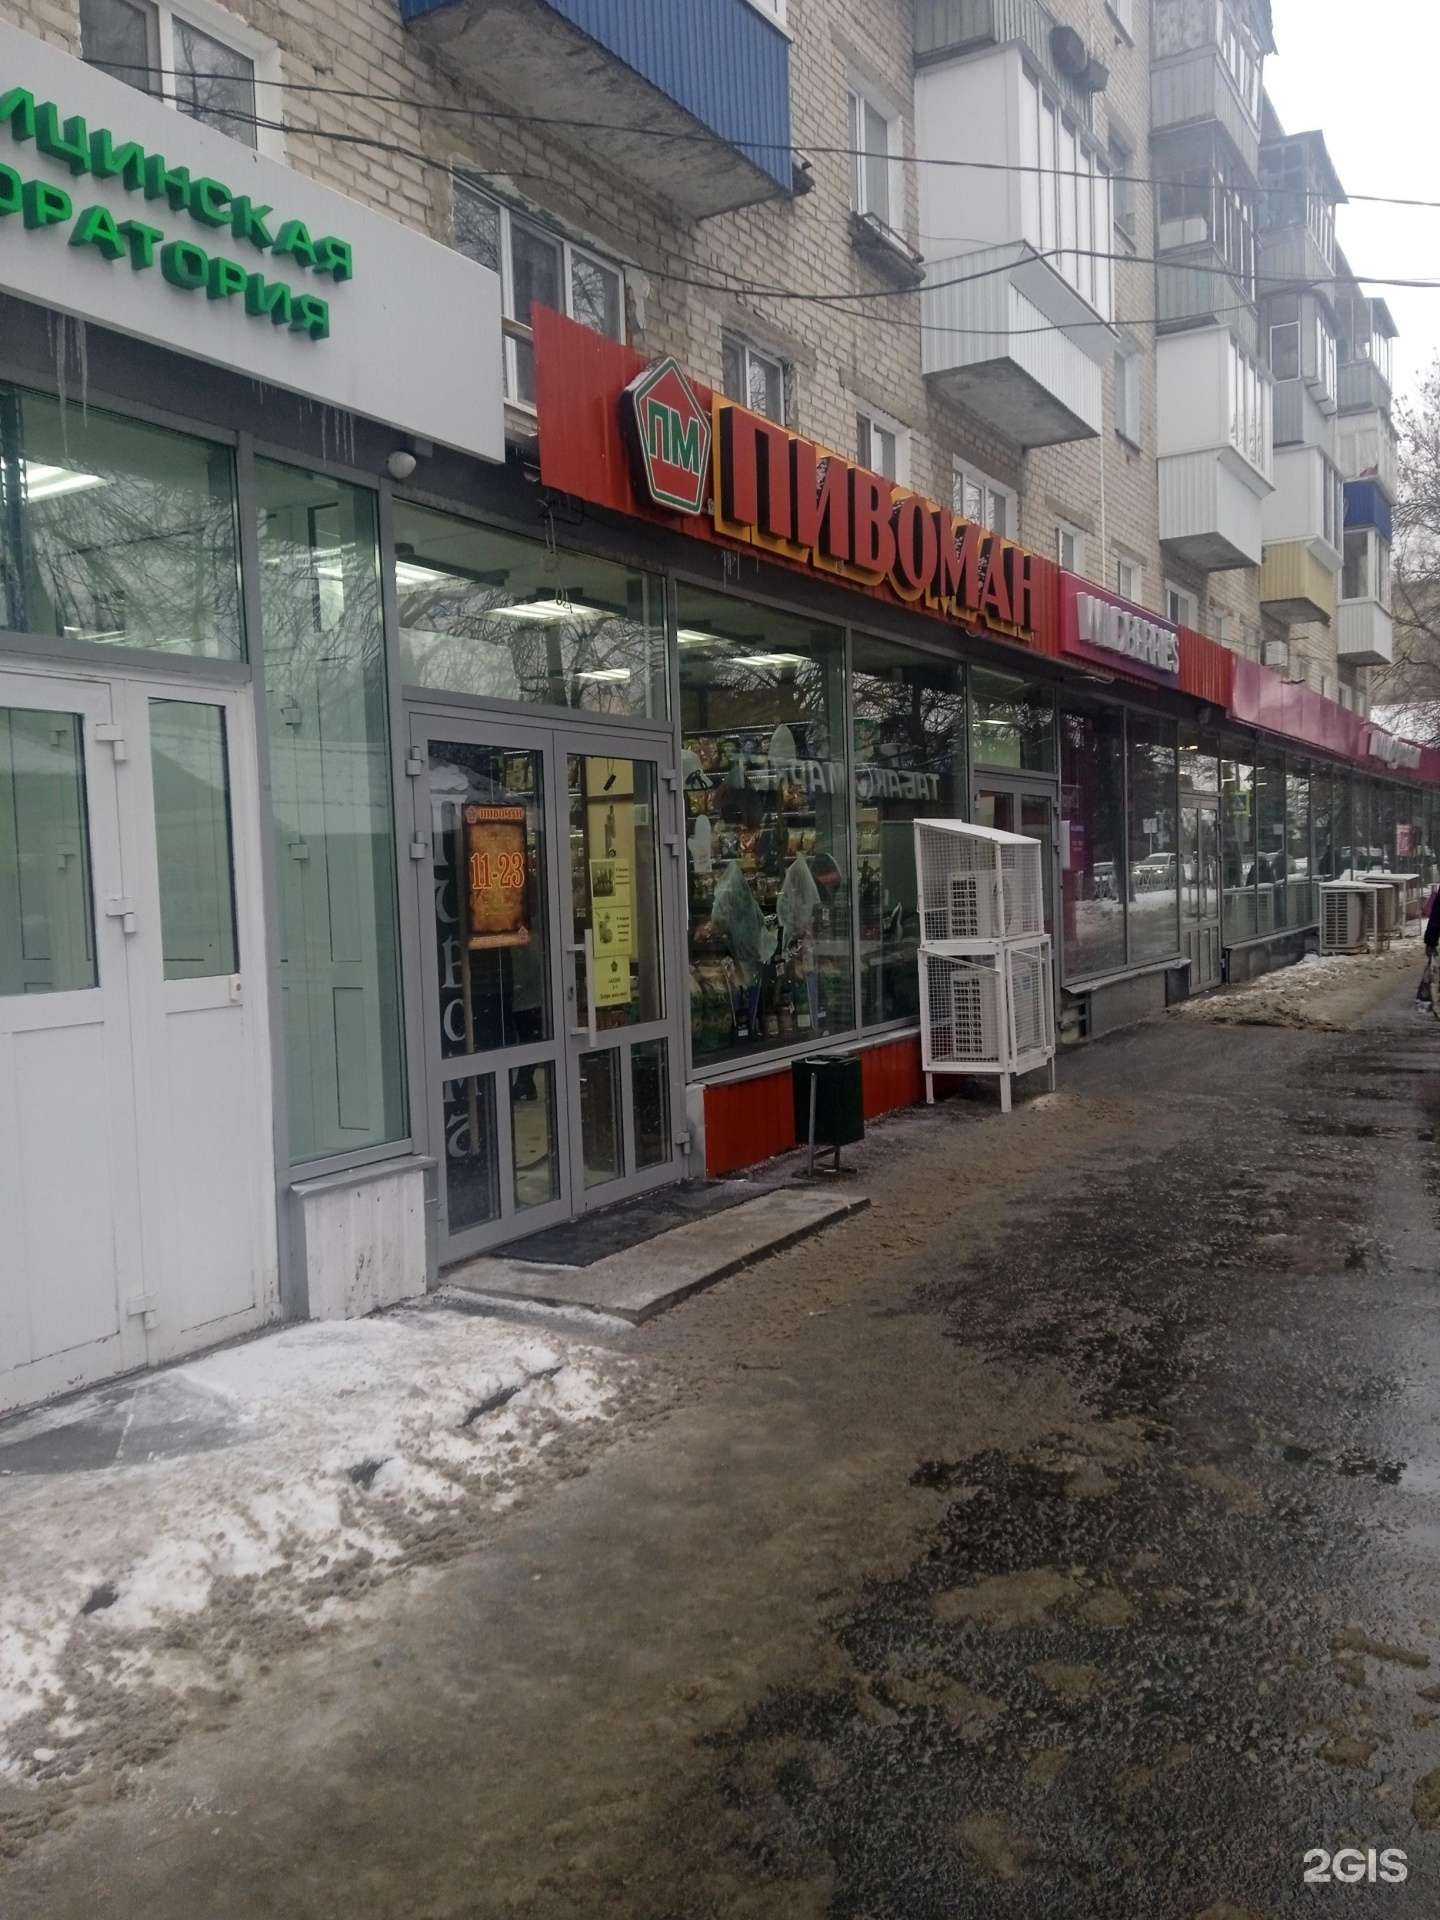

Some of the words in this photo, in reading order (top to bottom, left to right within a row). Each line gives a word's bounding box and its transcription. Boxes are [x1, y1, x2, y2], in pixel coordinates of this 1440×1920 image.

[647, 397, 701, 476] ПМ
[720, 406, 1041, 633] ПИВОМАН
[471, 852, 525, 890] 11-23
